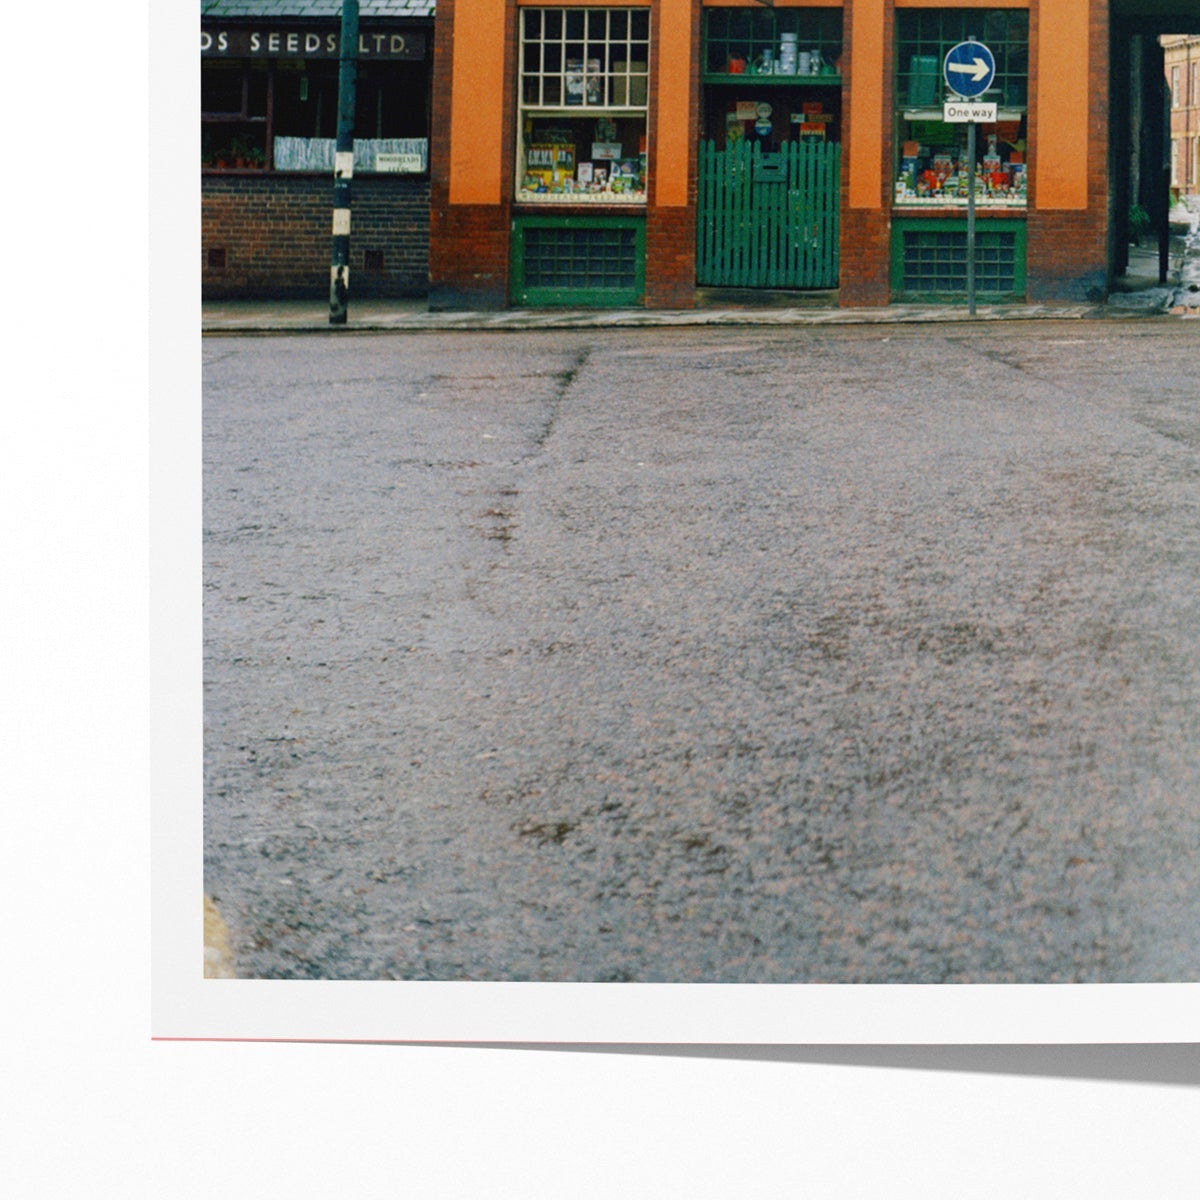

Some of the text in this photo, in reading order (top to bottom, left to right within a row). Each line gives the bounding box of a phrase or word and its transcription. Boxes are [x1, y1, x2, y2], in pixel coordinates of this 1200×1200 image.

[250, 32, 337, 52] SEEDS
[358, 34, 410, 53] LTD.
[947, 107, 993, 120] One way
